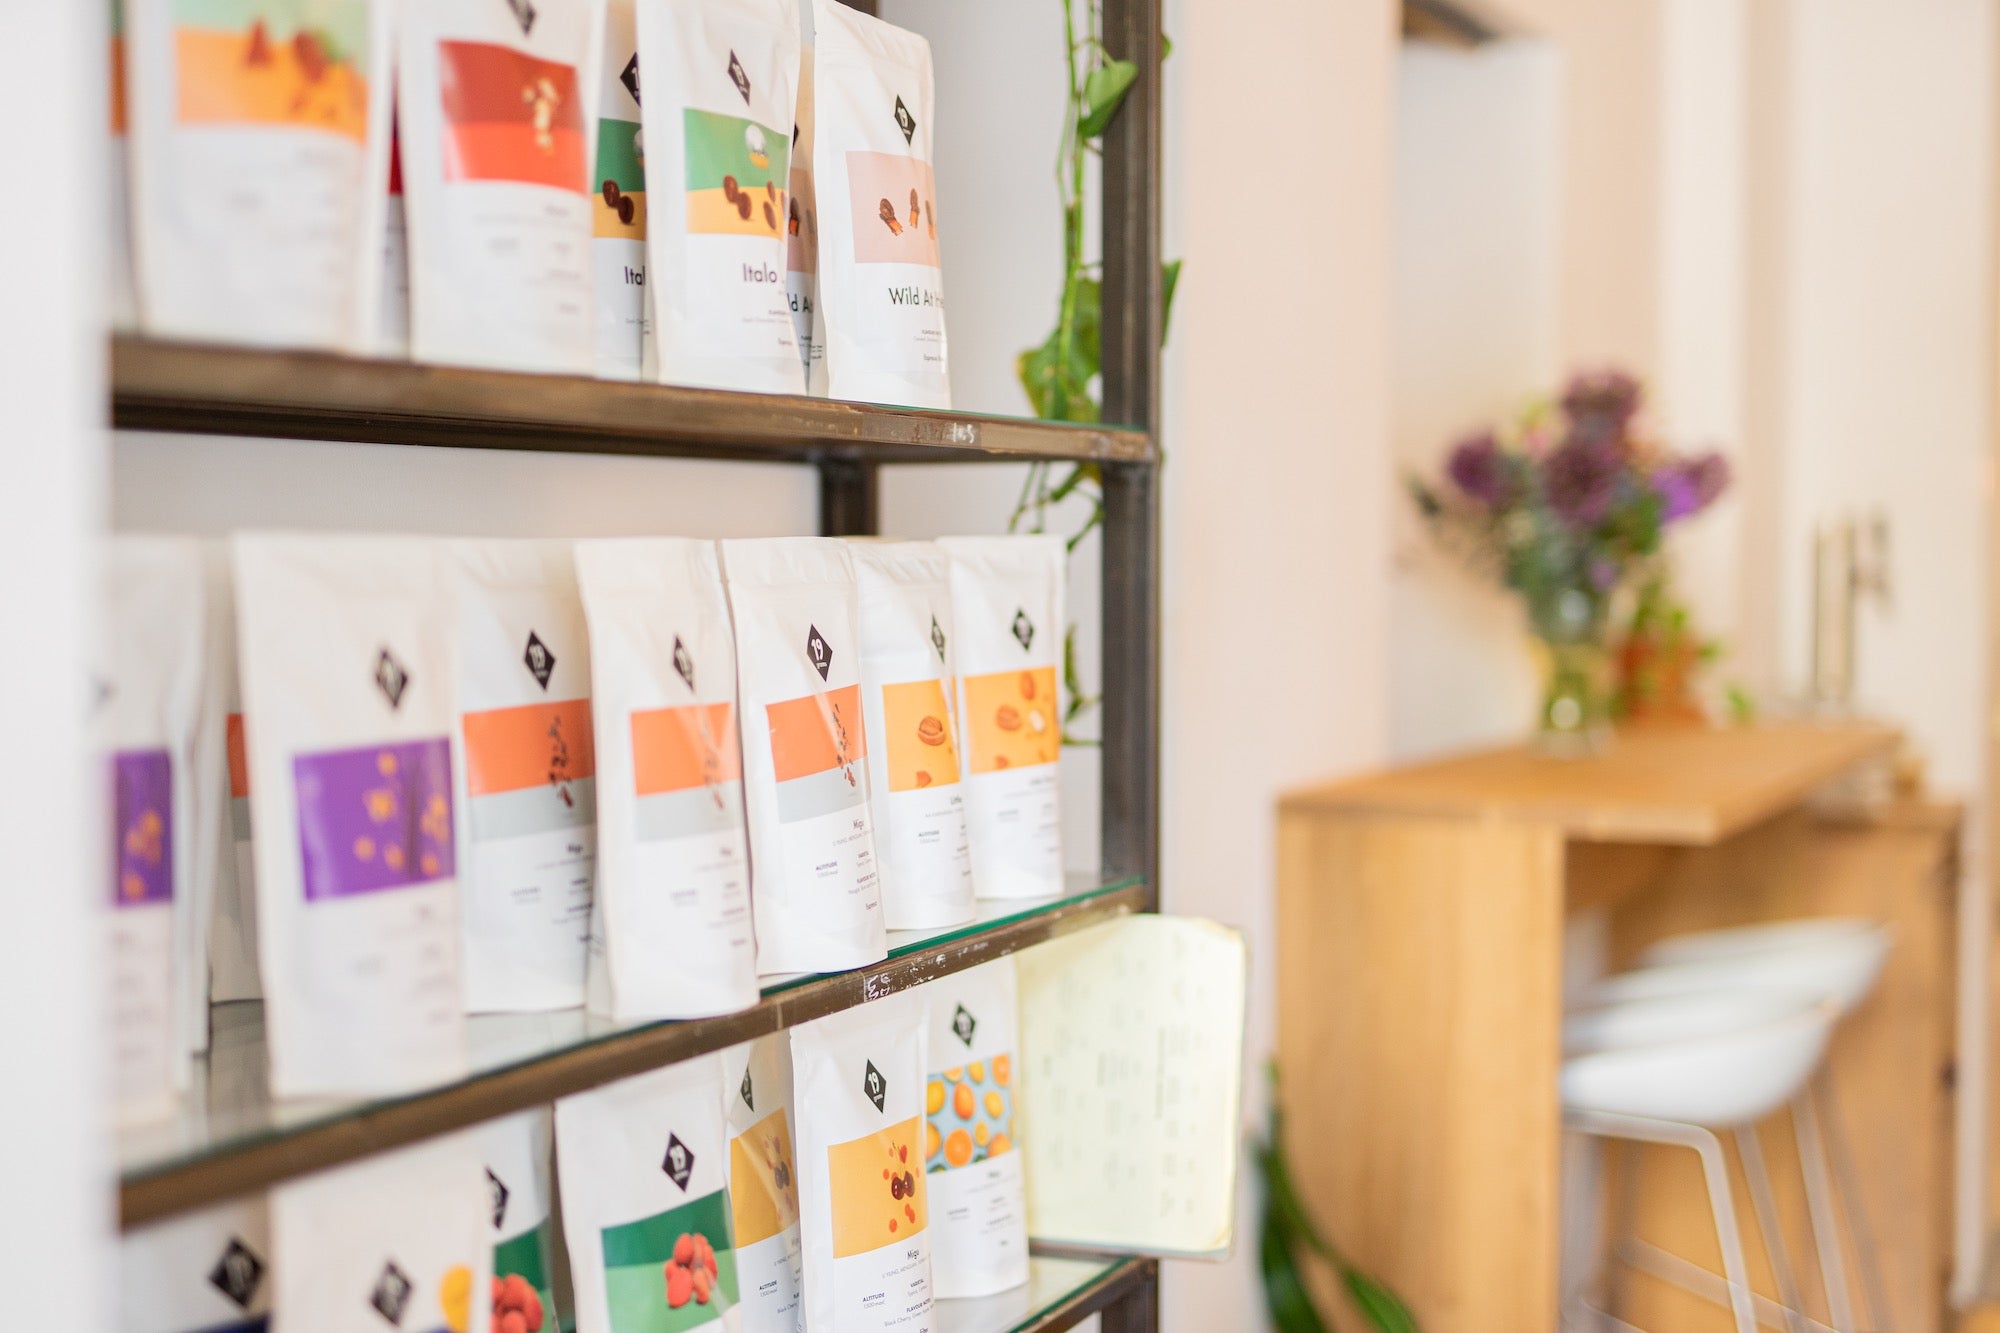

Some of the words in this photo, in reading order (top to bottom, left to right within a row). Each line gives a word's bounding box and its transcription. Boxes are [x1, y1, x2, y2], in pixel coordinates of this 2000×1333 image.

[624, 265, 646, 286] Ital
[742, 261, 778, 283] Italo
[888, 286, 920, 305] Wild
[810, 638, 824, 661] 19
[868, 1071, 880, 1094] 19
[862, 1292, 885, 1302] ALTITUDE
